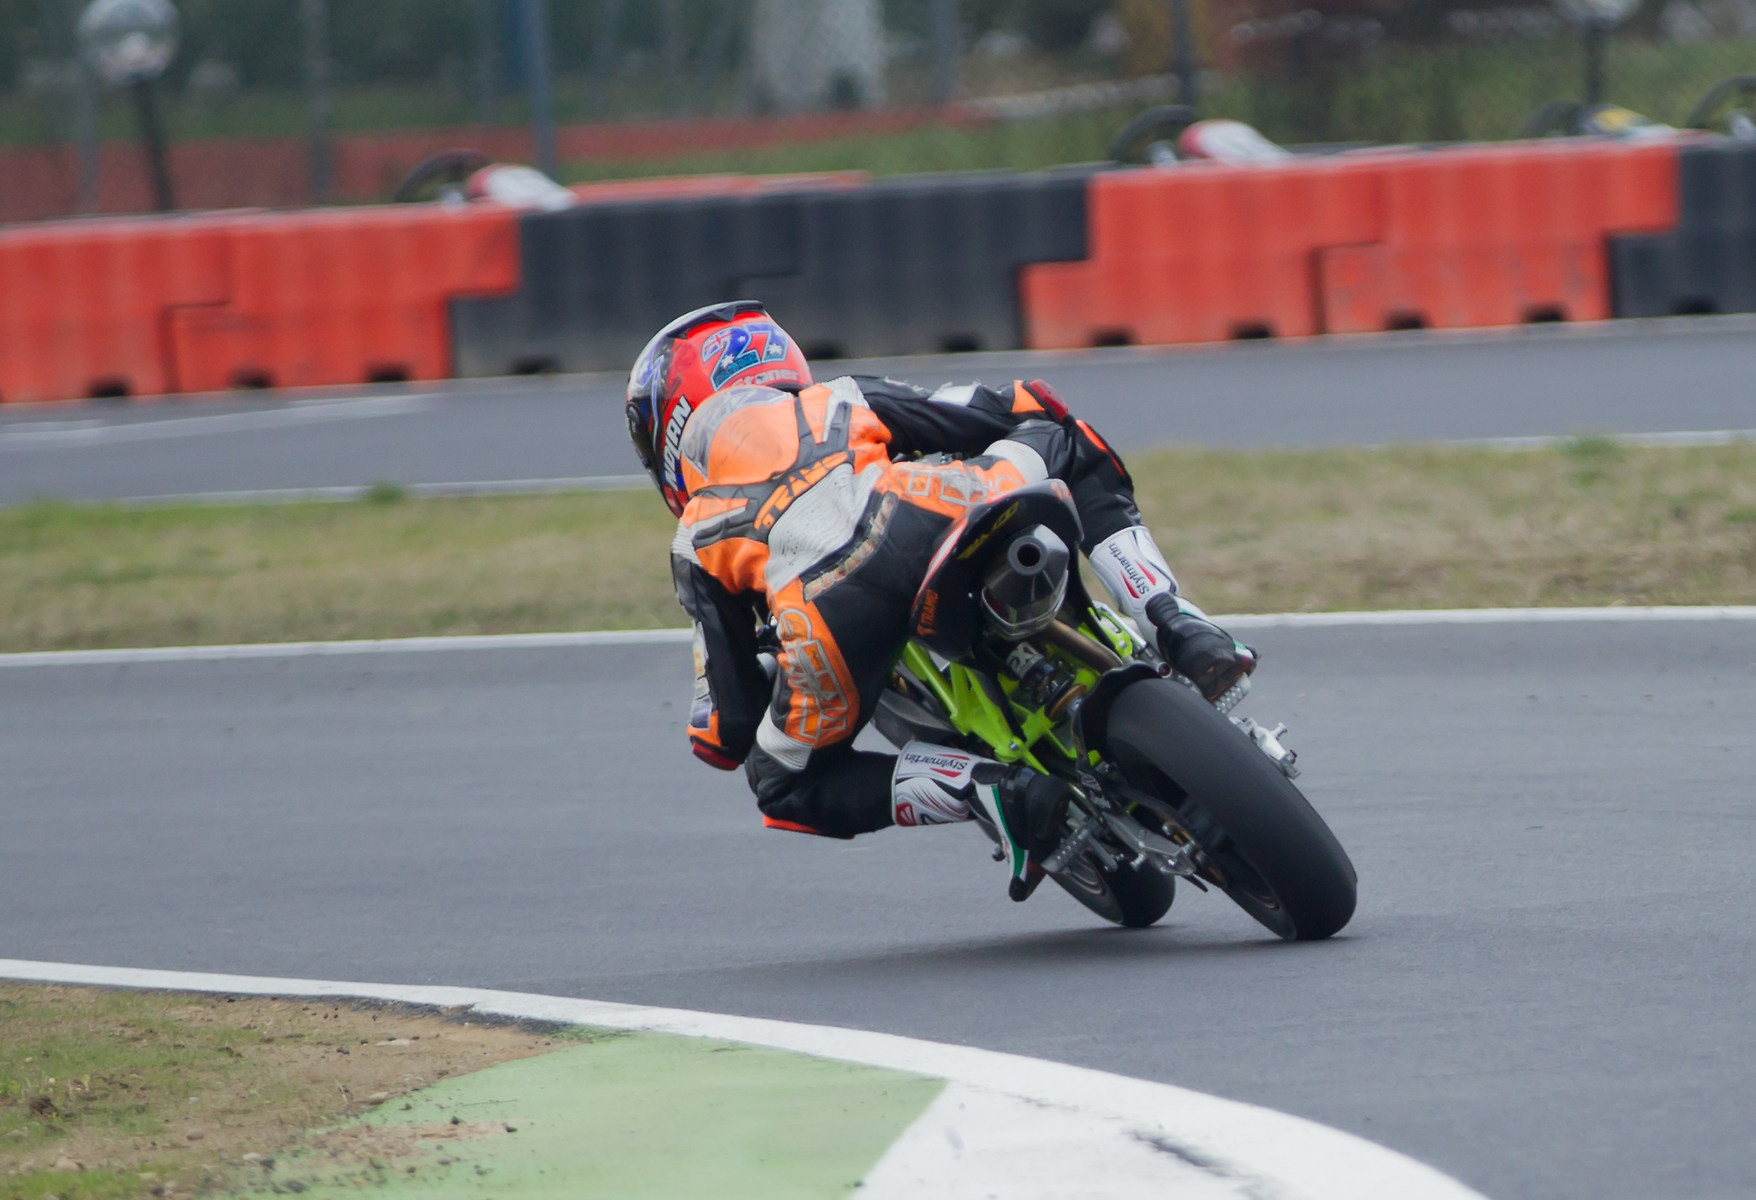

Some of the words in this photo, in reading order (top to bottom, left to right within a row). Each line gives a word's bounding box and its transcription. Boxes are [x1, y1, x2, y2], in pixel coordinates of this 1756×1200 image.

[702, 322, 789, 392] 27
[663, 394, 692, 493] NOLAN
[1108, 543, 1150, 595] Stylmartin
[904, 753, 969, 770] Stylmartin
